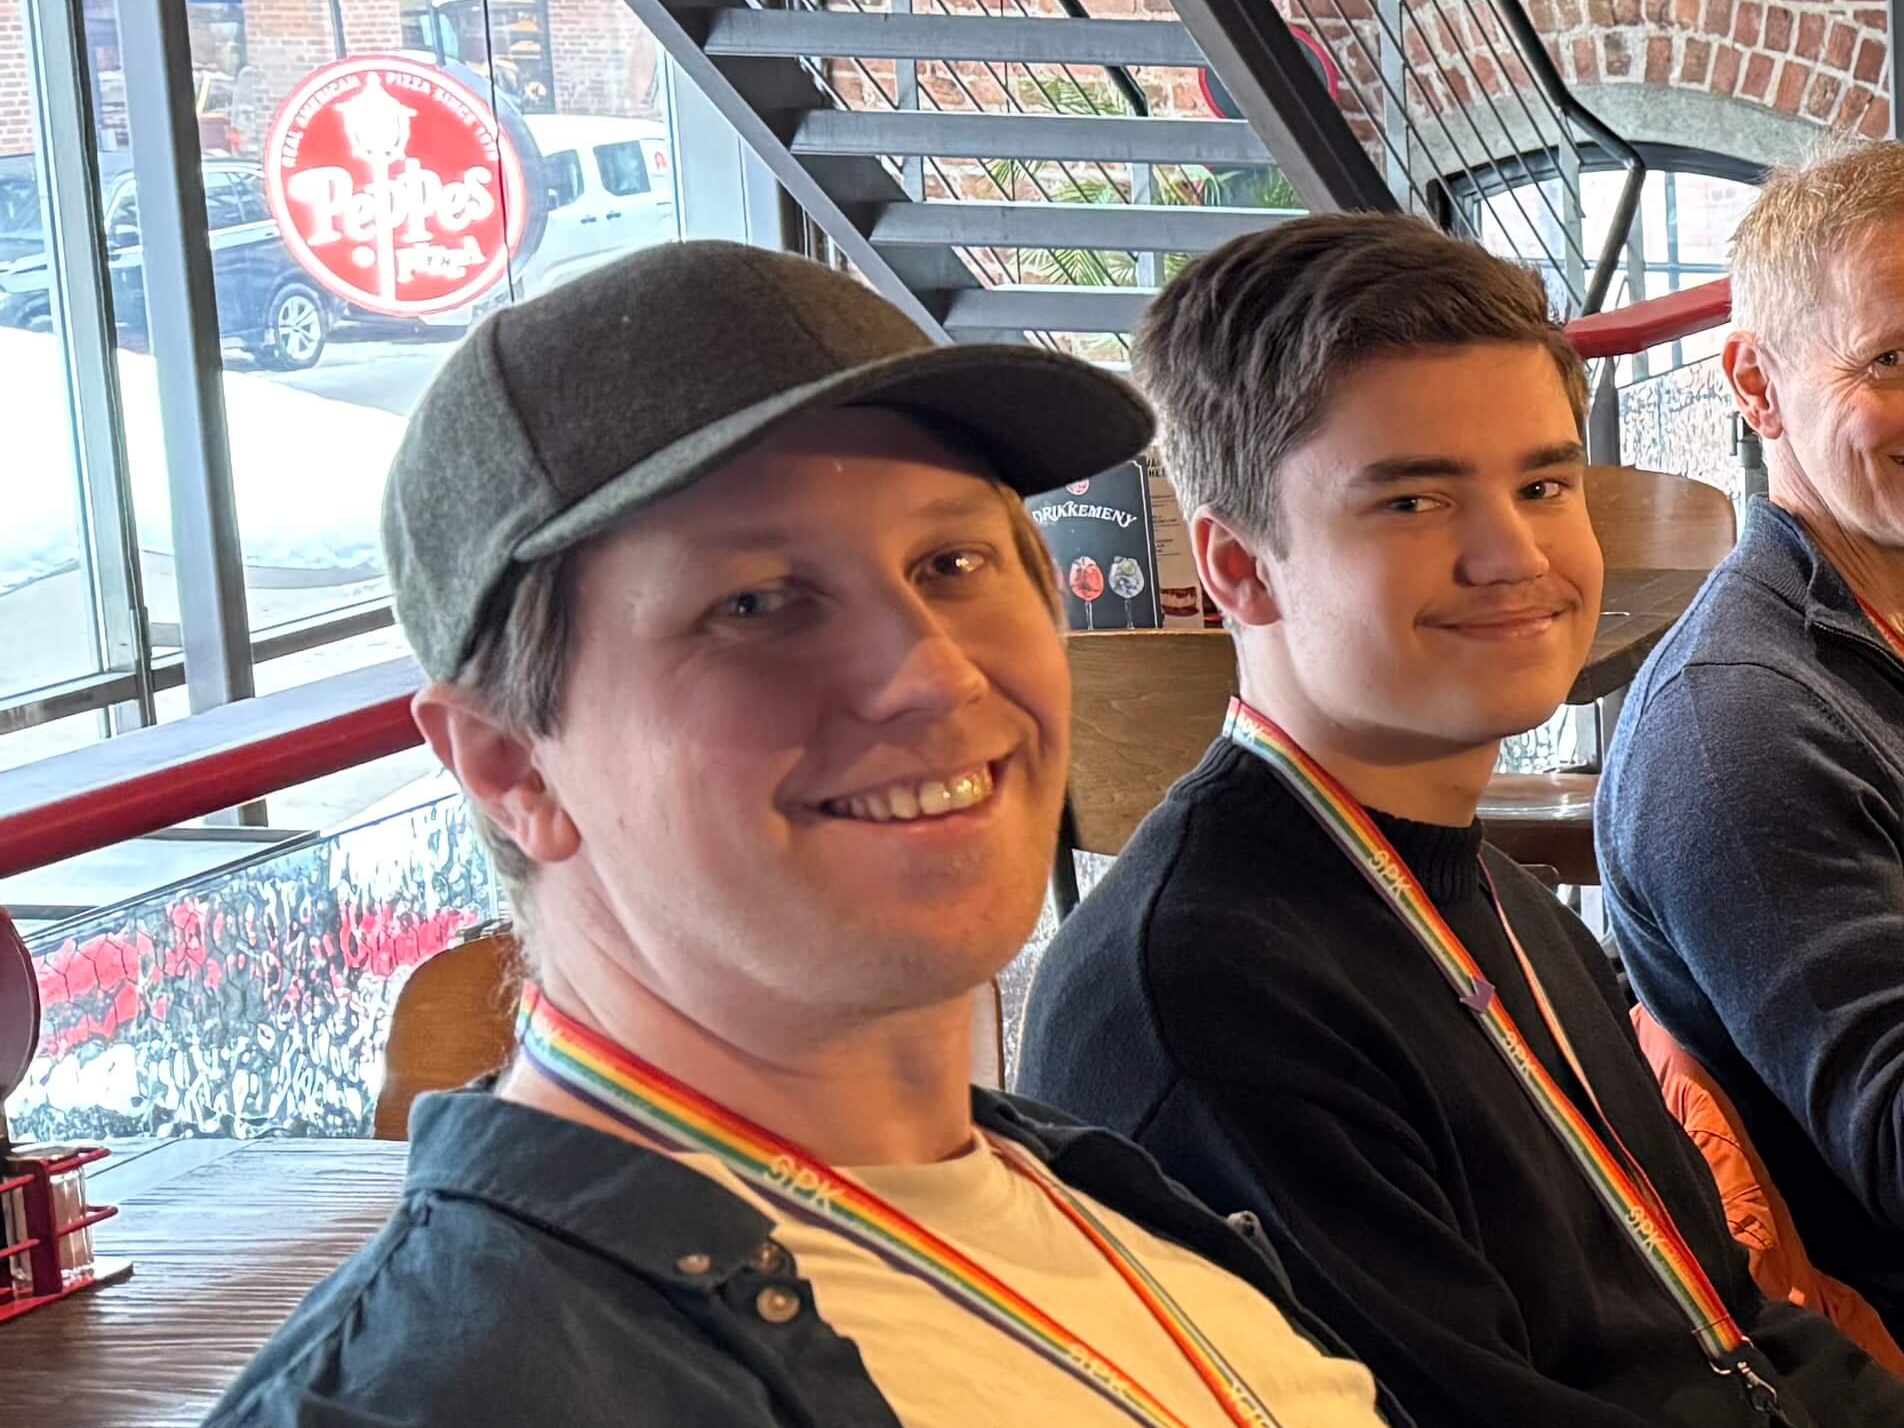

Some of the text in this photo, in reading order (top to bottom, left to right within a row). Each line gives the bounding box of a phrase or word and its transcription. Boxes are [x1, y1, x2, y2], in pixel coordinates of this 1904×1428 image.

[1032, 500, 1138, 528] DRIKKEMENY
[1369, 850, 1412, 899] SPK
[762, 1154, 848, 1212] SPK
[1625, 1206, 1667, 1253] SPK
